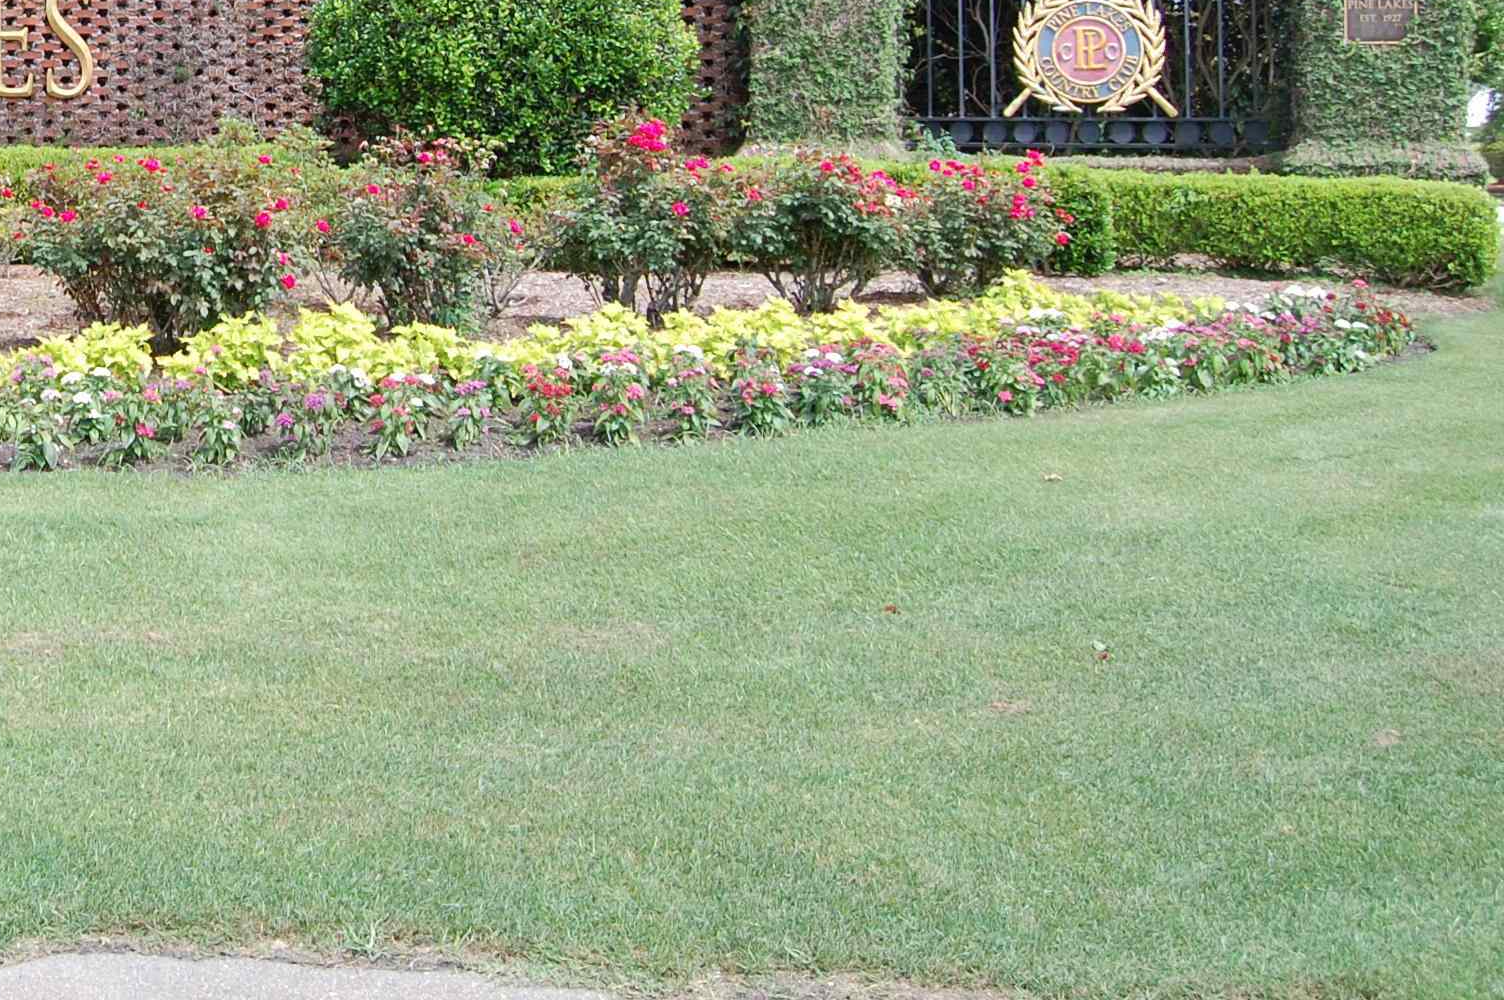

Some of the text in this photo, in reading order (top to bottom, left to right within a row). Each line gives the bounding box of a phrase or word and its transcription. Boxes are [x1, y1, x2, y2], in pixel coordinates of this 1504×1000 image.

[1045, 3, 1130, 32] PINE LAKES
[1348, 0, 1413, 9] PINE LAKES
[1039, 55, 1138, 98] COUNTRY CLUB
